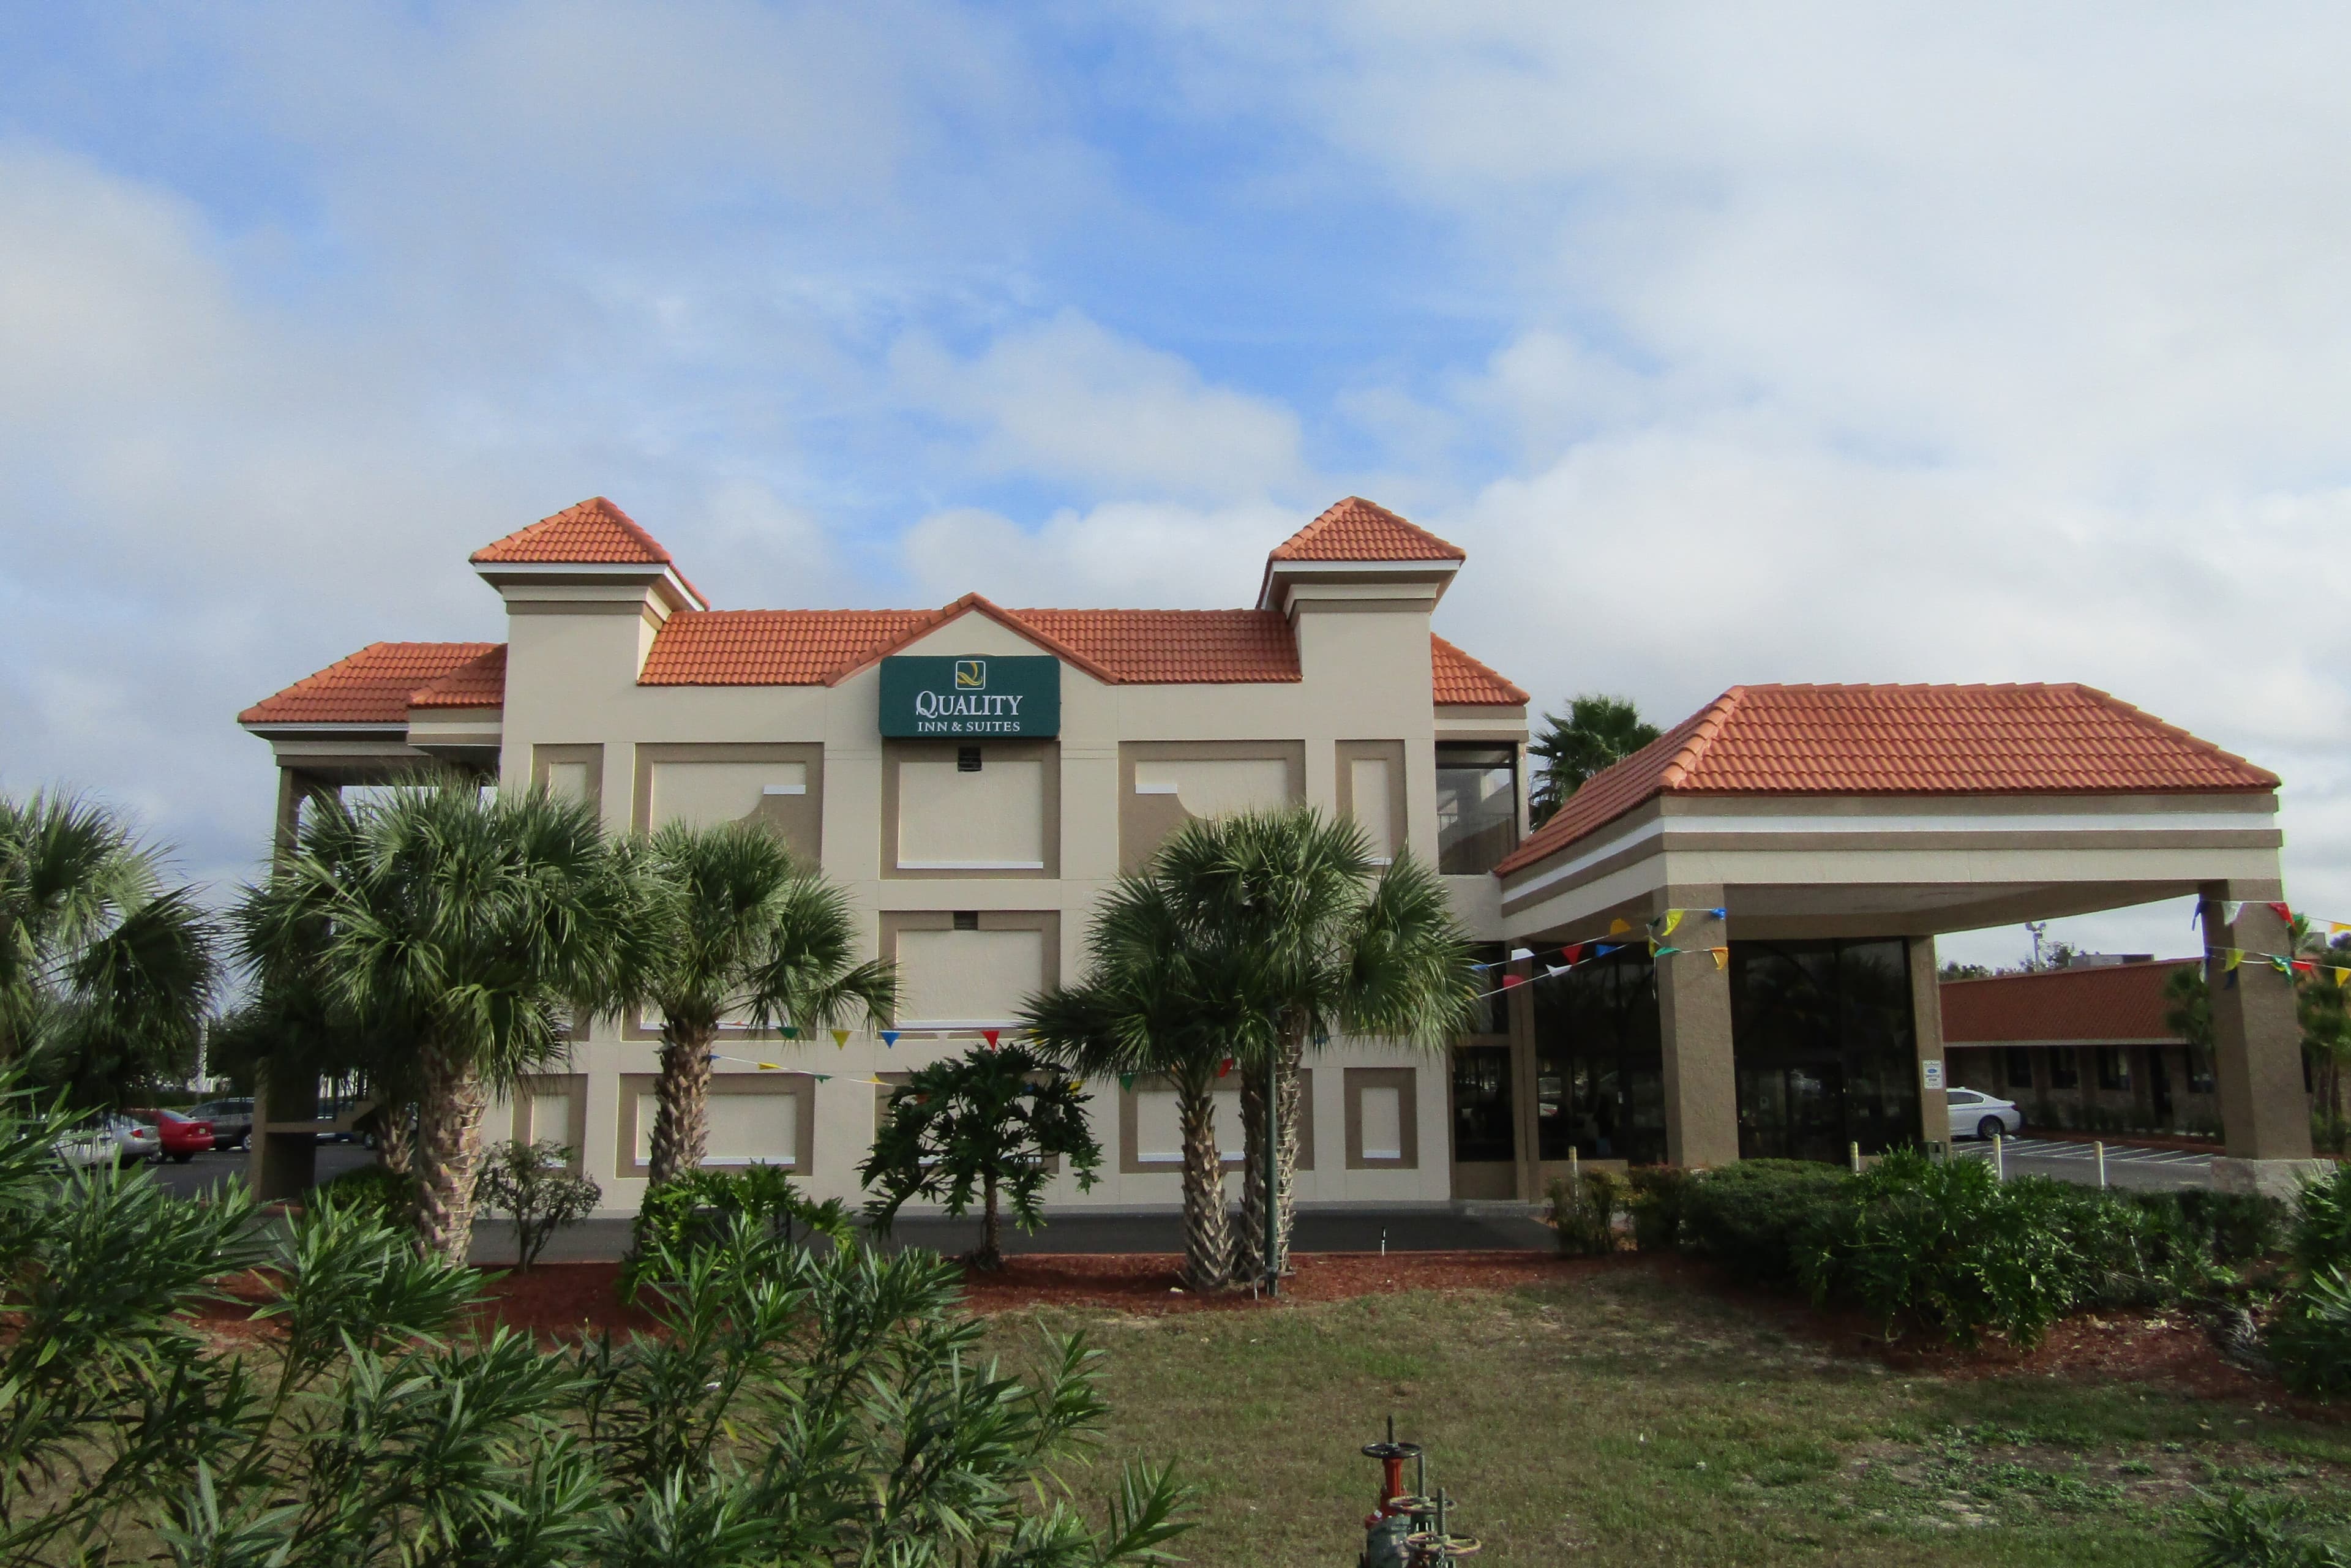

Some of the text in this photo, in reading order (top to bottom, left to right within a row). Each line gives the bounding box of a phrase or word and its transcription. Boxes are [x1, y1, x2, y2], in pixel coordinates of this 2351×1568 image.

[916, 691, 1023, 718] QUALITY
[918, 722, 1020, 732] INN & SUITES
